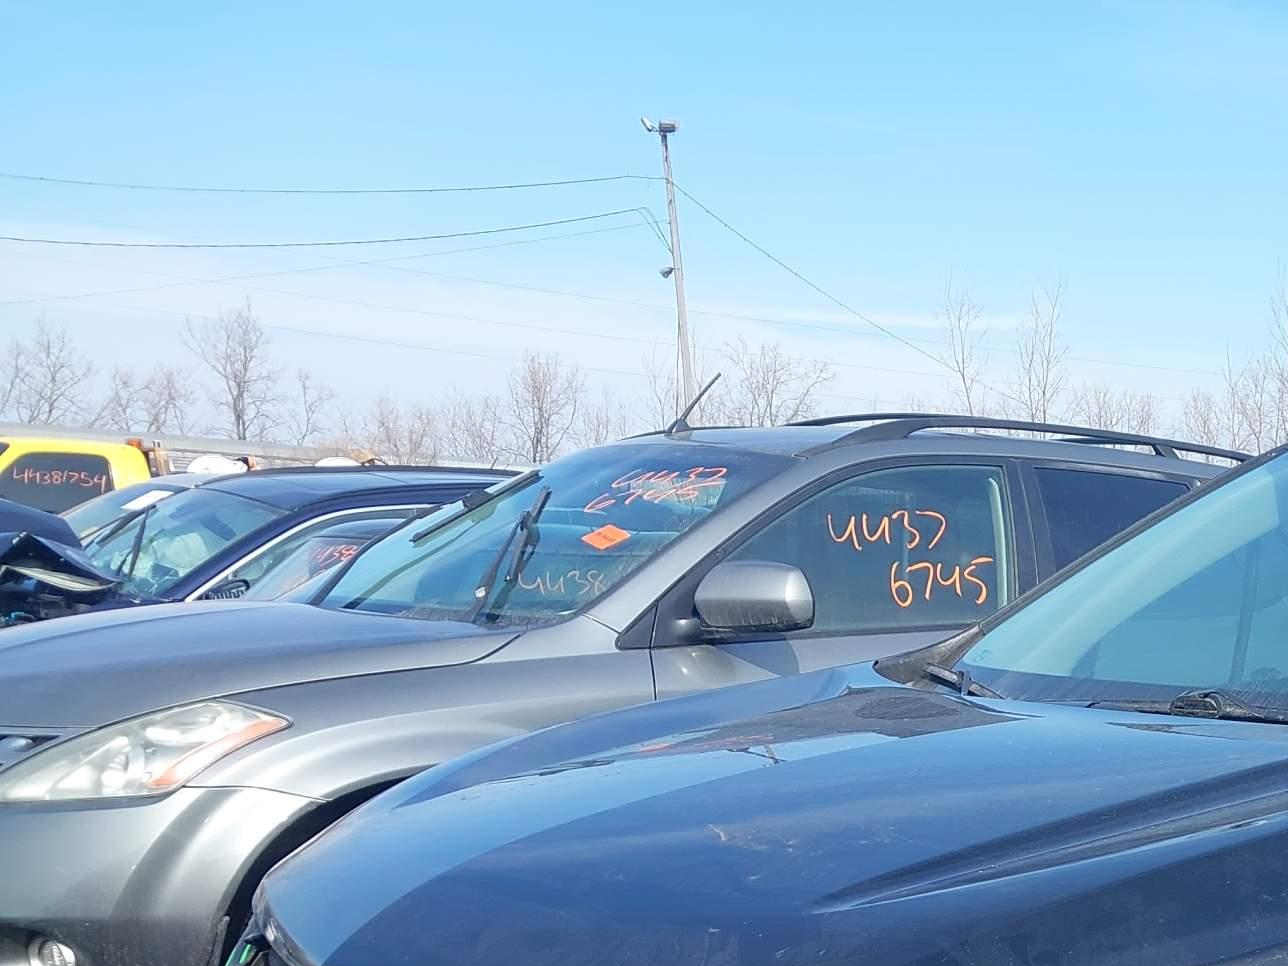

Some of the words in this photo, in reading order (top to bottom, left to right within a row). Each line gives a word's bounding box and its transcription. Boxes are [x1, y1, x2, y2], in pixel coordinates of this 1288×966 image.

[12, 466, 107, 495] 44381754
[826, 510, 947, 551] 4437
[890, 557, 993, 607] 6745
